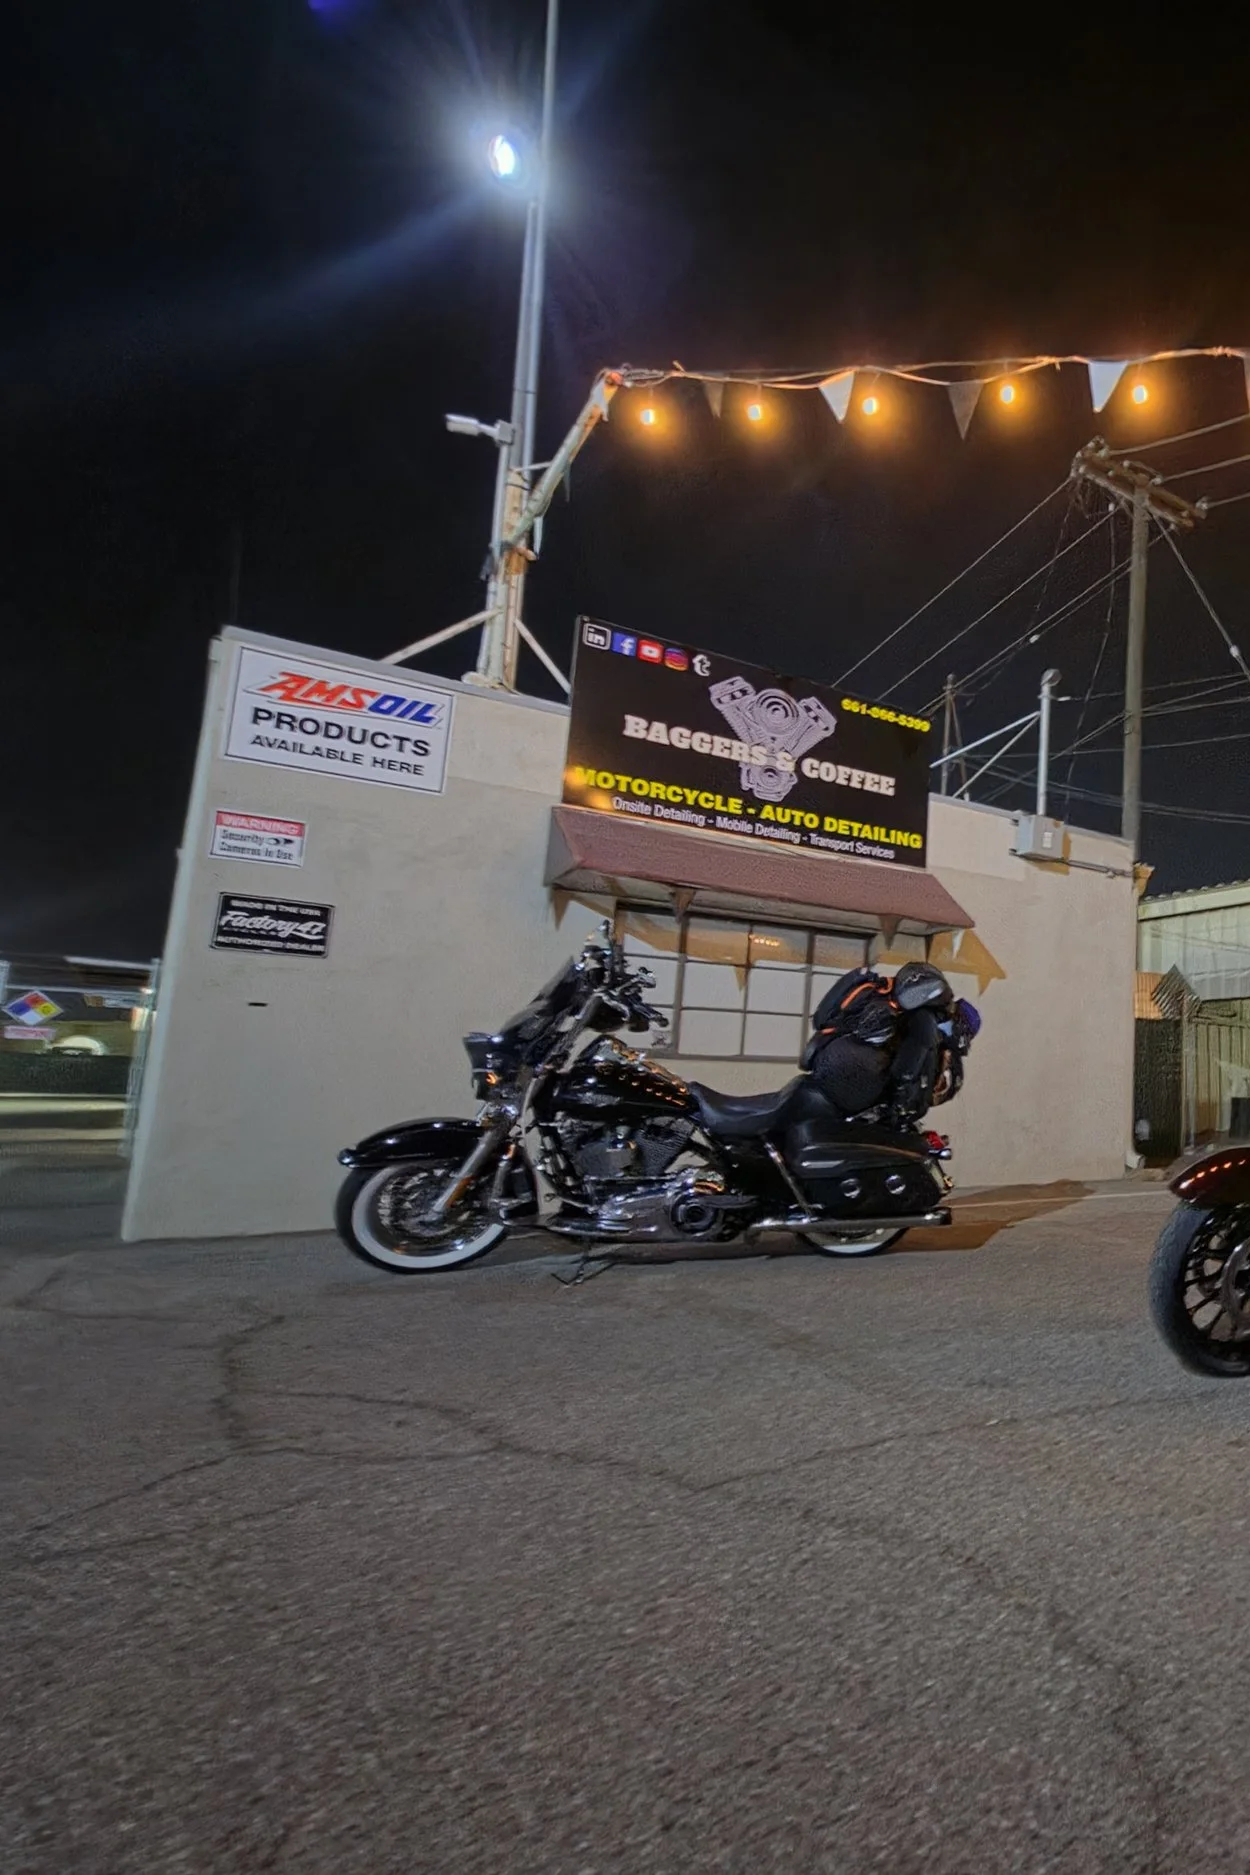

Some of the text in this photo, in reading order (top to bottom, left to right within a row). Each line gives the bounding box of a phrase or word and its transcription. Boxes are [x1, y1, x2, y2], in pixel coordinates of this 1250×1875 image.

[260, 671, 438, 724] AMSOIL
[250, 734, 425, 776] AVAILABLE HERE
[252, 706, 430, 757] PRODUCTS
[623, 714, 896, 797] BAGGERS & COFFEE
[572, 765, 743, 815] MOTORCYCLE
[760, 804, 819, 829] AUTO
[823, 816, 923, 849] DETAILING
[612, 796, 651, 816] Onsite
[654, 804, 707, 828] Detailing
[716, 815, 753, 835] Mobile
[755, 822, 801, 845] Detailing
[809, 833, 854, 853] Transport
[855, 842, 896, 860] Services
